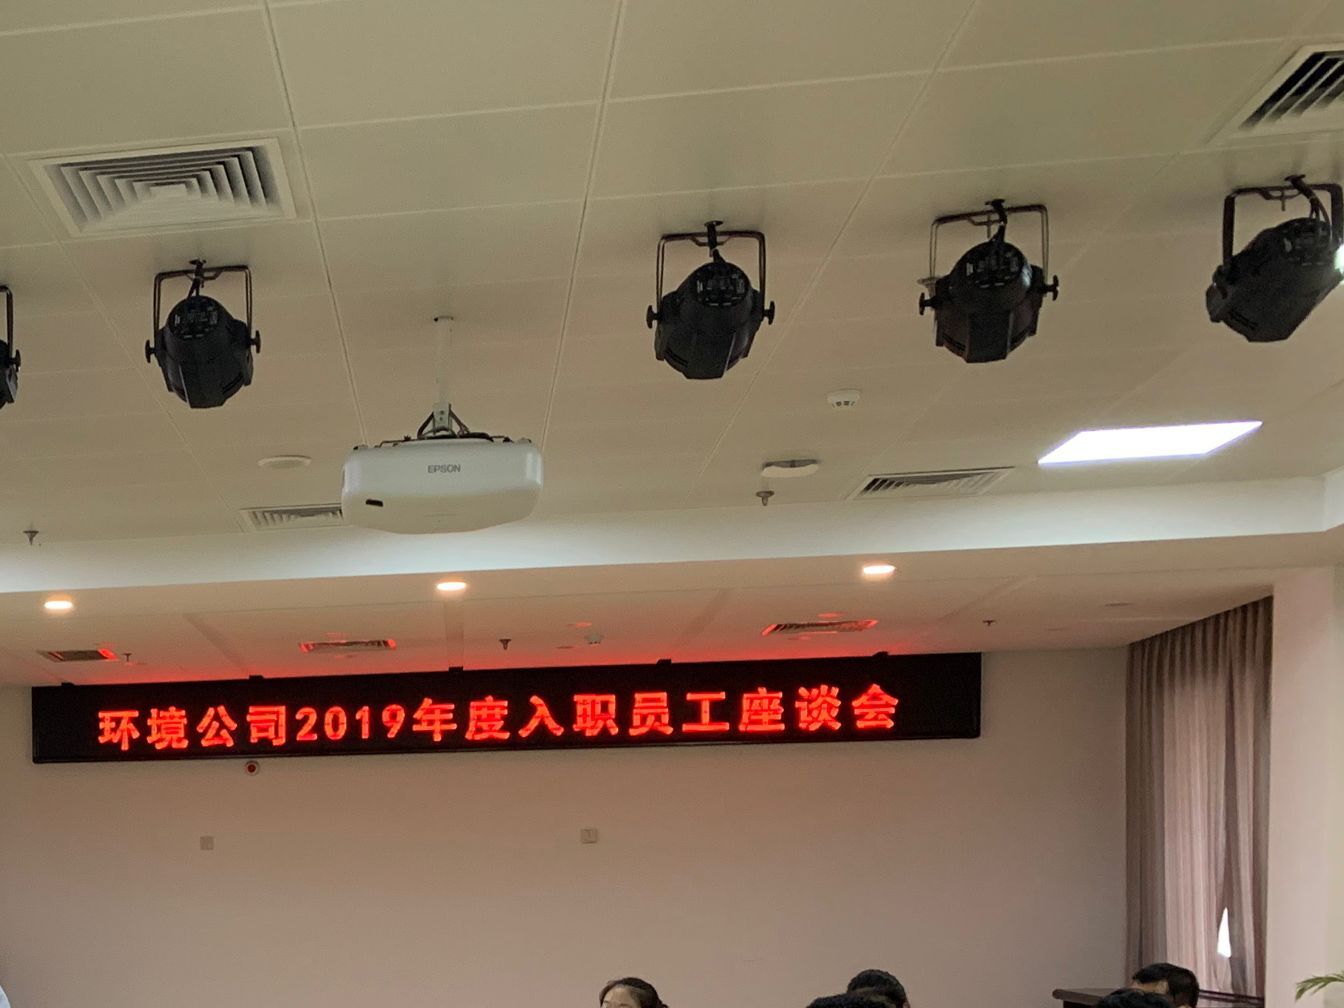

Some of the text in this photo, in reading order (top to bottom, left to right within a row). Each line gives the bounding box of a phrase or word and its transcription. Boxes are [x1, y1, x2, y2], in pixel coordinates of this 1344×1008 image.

[427, 464, 461, 473] EPSON
[97, 684, 899, 751] 环境公司2019年度入职员工座谈会
